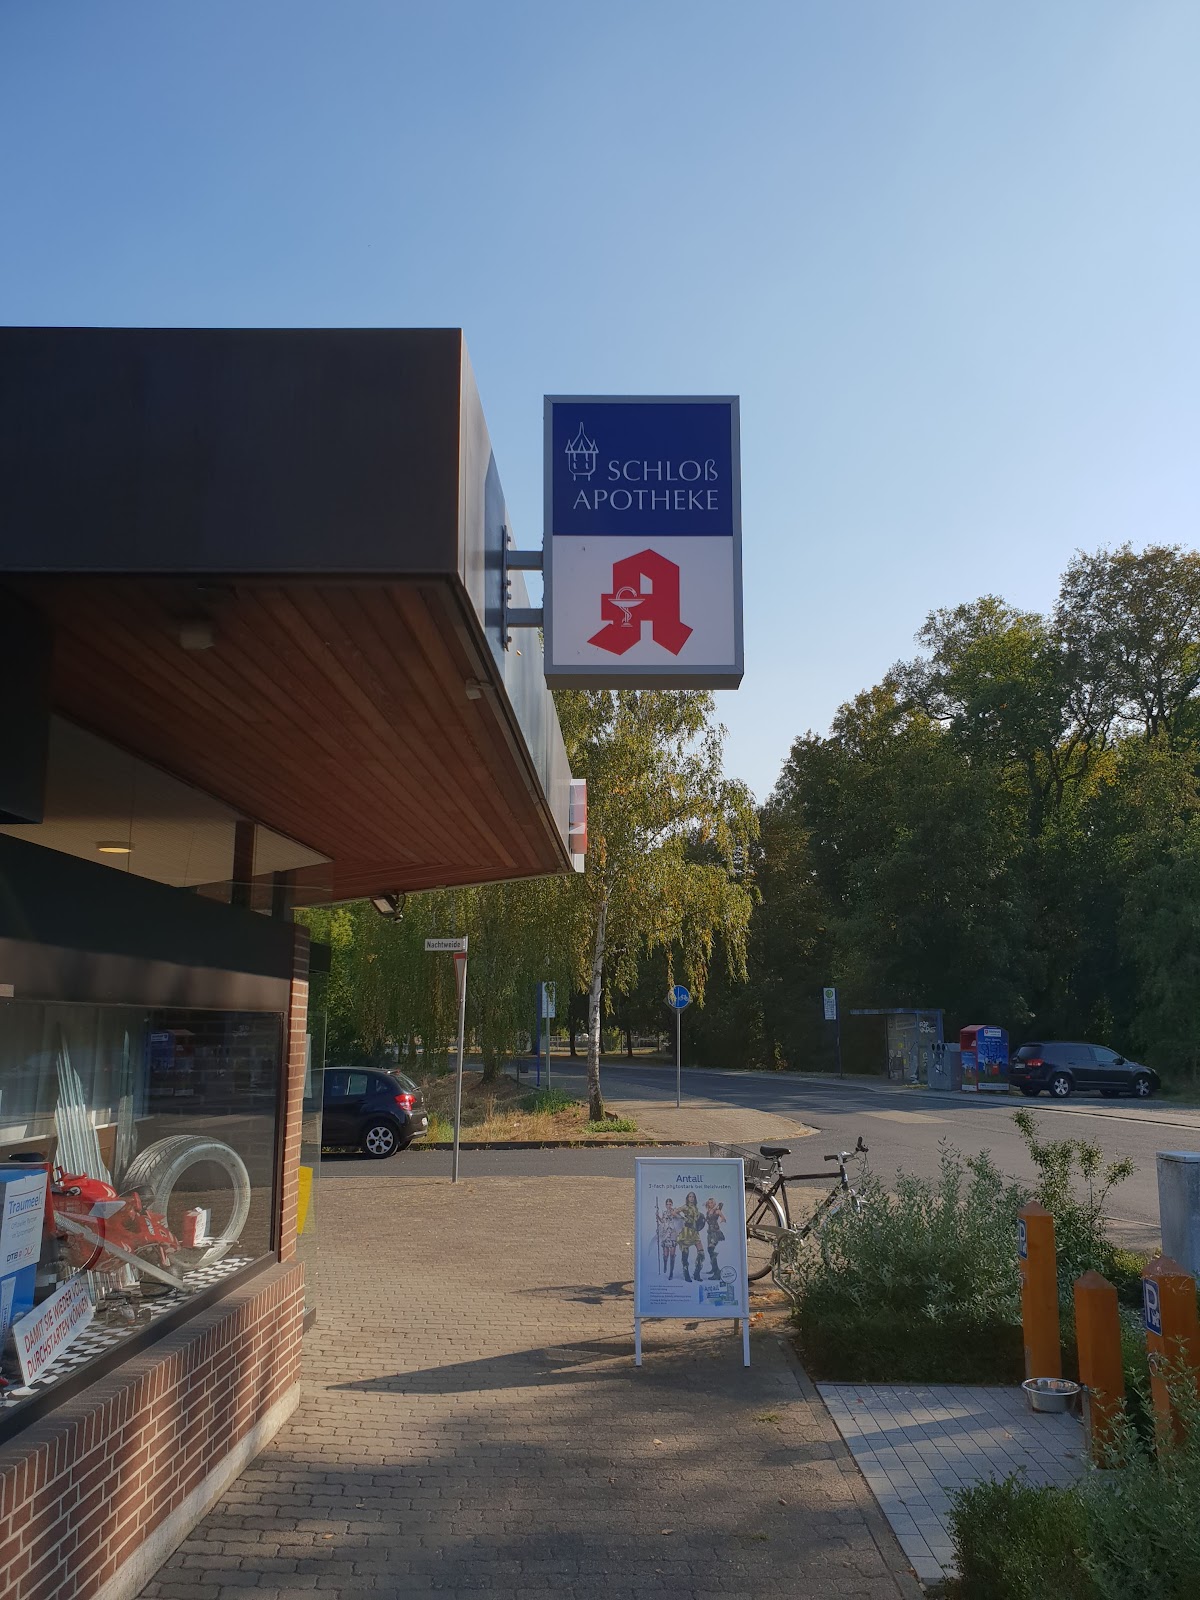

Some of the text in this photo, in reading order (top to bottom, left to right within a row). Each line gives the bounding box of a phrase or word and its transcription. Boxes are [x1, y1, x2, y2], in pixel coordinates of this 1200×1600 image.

[608, 459, 719, 481] SCHLOß
[573, 489, 719, 511] APOTHEKE
[426, 941, 461, 949] Nachtweide
[676, 1174, 704, 1183] Antall
[24, 1318, 44, 1353] DAMIT
[44, 1309, 54, 1331] SIE
[52, 1289, 72, 1321] WIEDER
[26, 1316, 70, 1378] DURCHSTARTEN
